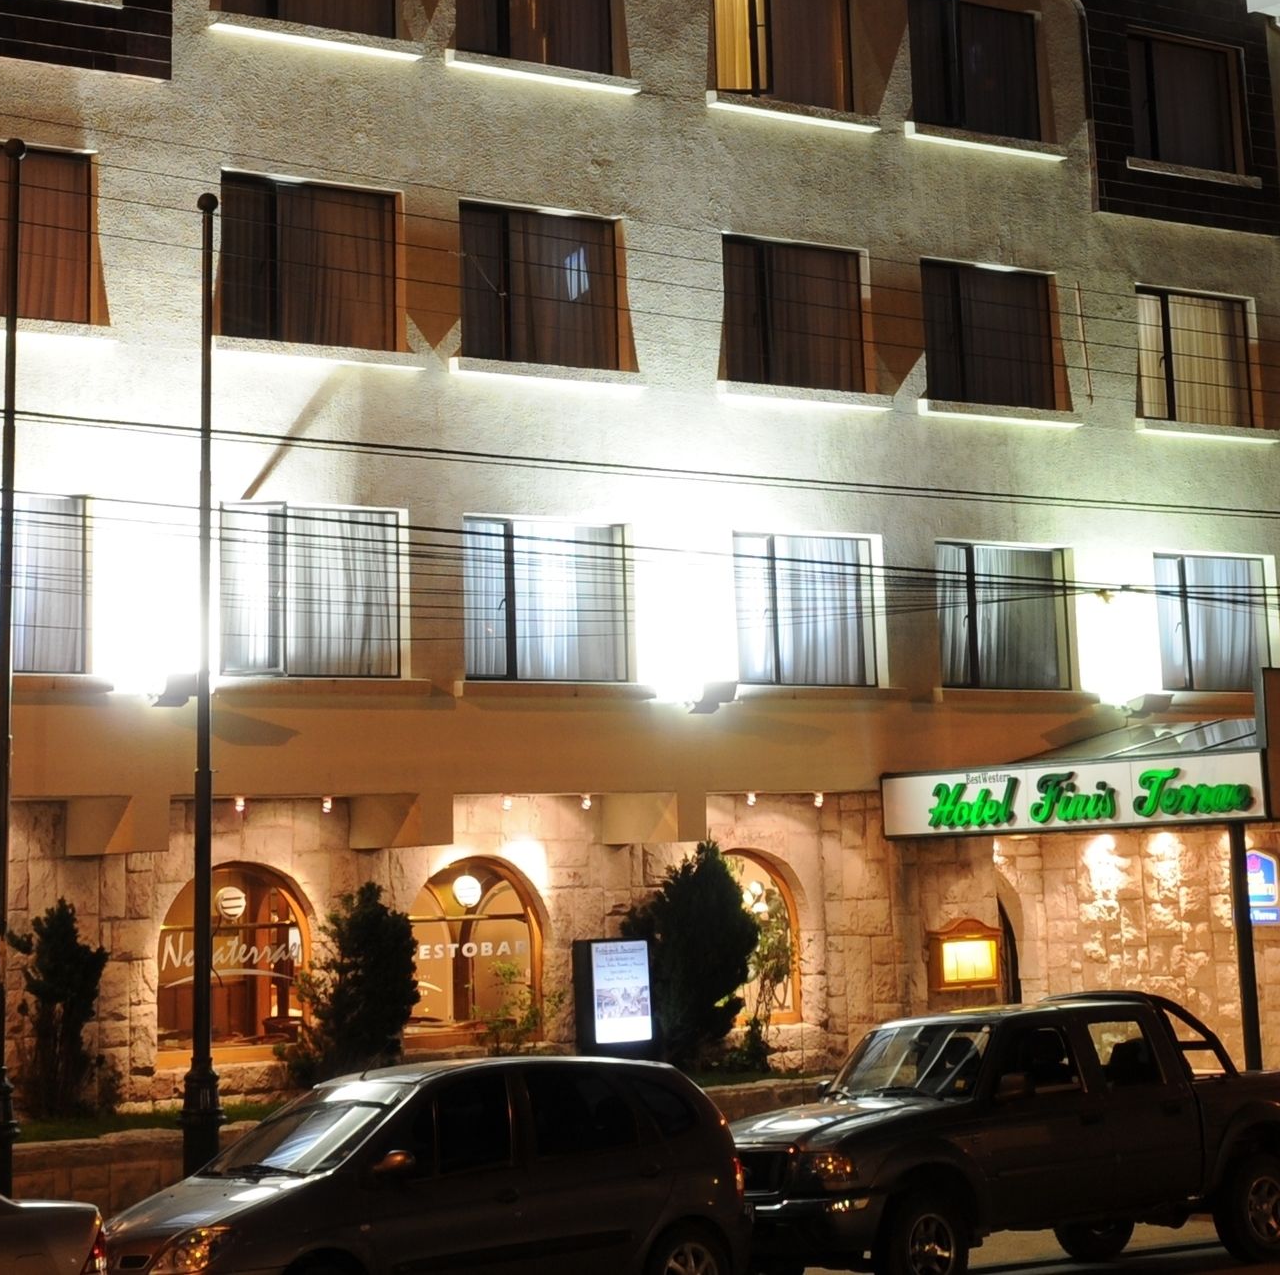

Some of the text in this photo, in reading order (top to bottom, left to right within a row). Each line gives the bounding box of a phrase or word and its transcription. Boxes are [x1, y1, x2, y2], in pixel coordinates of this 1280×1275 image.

[928, 776, 1019, 829] Hotel
[1029, 771, 1117, 824] Finis
[161, 931, 301, 972] Noaterrae
